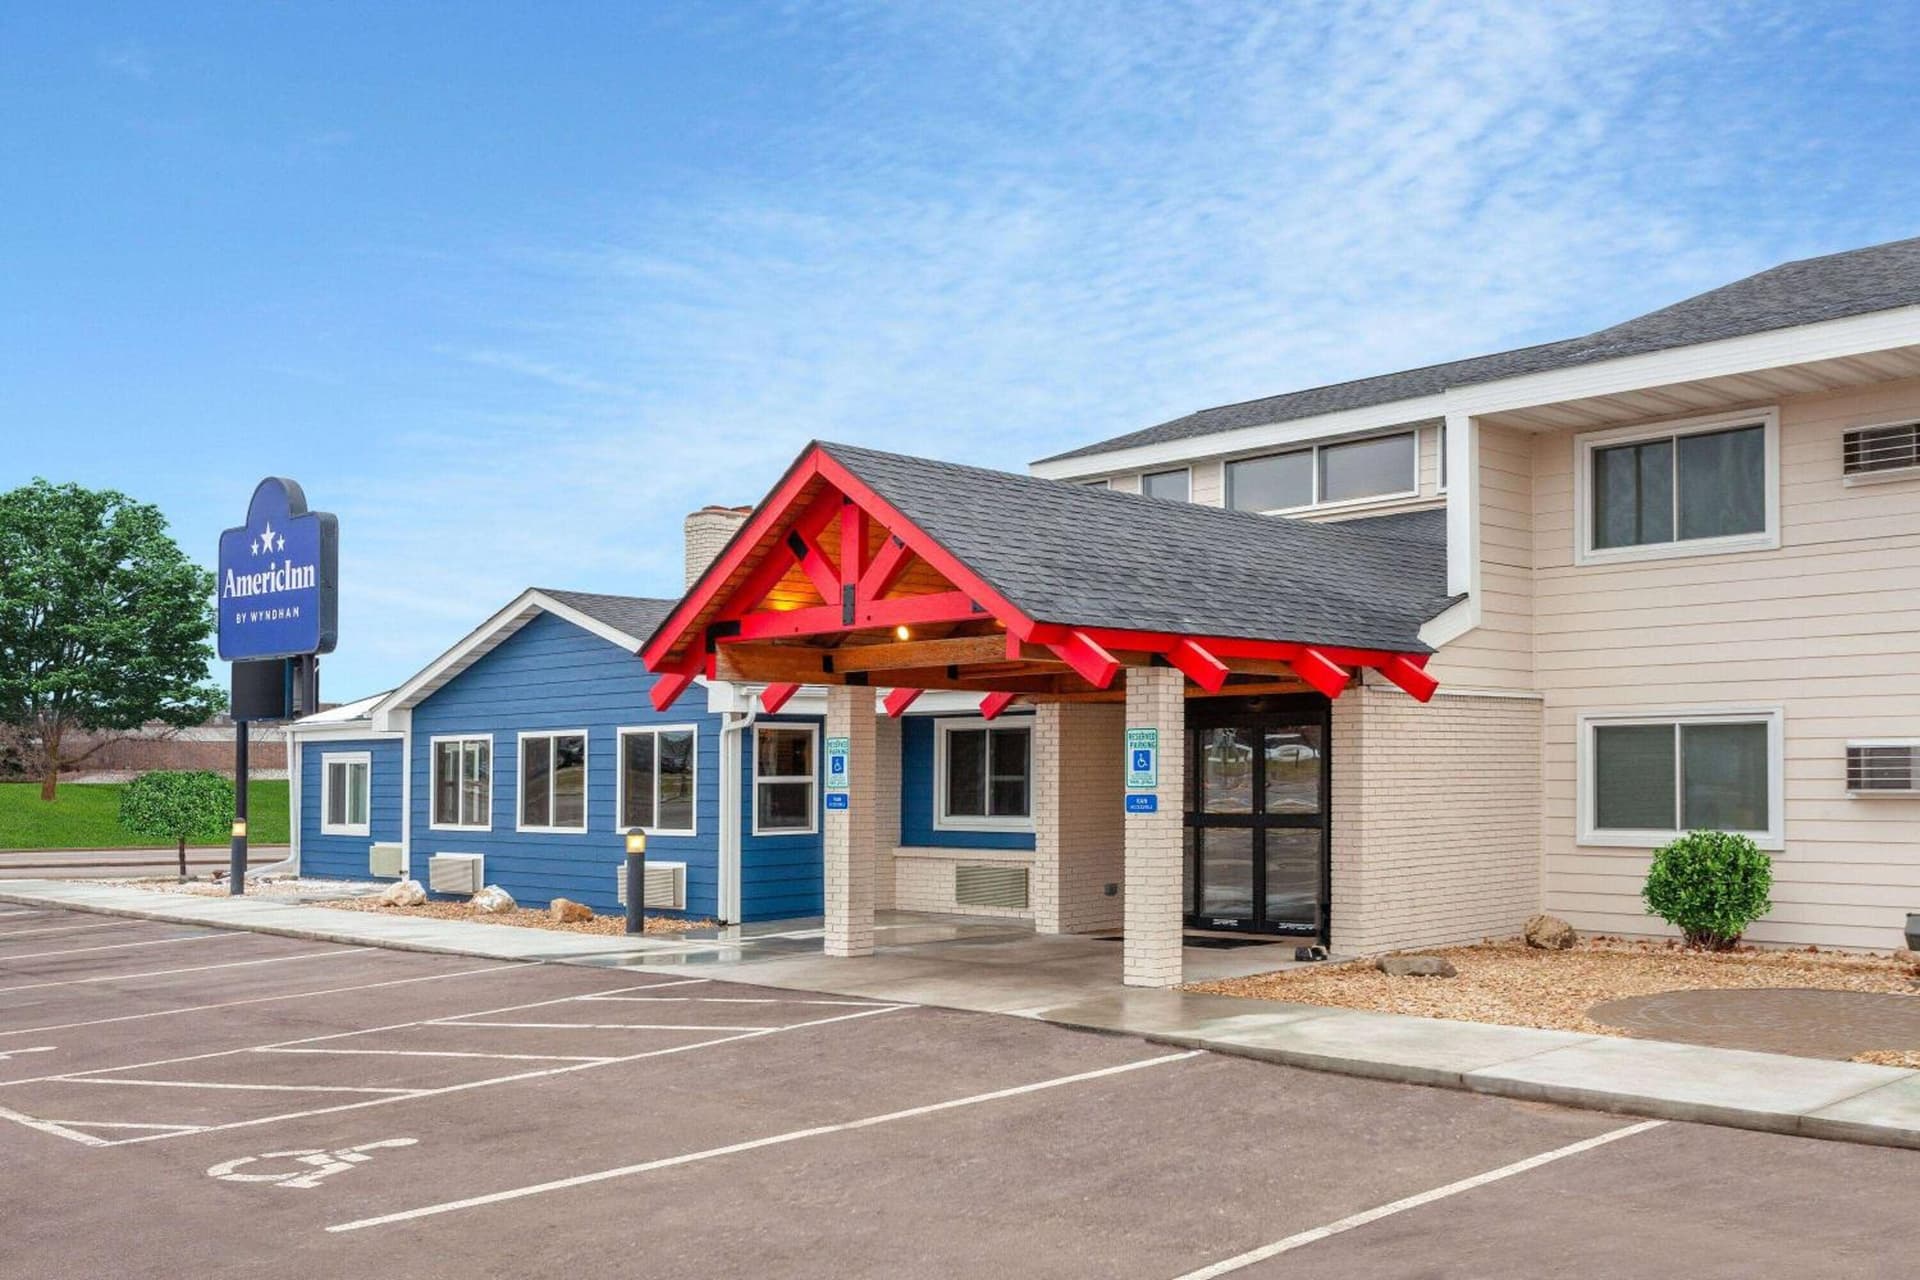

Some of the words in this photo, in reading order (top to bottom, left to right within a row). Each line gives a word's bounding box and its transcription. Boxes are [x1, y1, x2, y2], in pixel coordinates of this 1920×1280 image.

[223, 559, 315, 598] AmericInn
[236, 612, 247, 624] BY
[250, 606, 299, 622] WYNDHAM
[1128, 732, 1156, 740] RESERVED
[1129, 741, 1156, 749] PARKING
